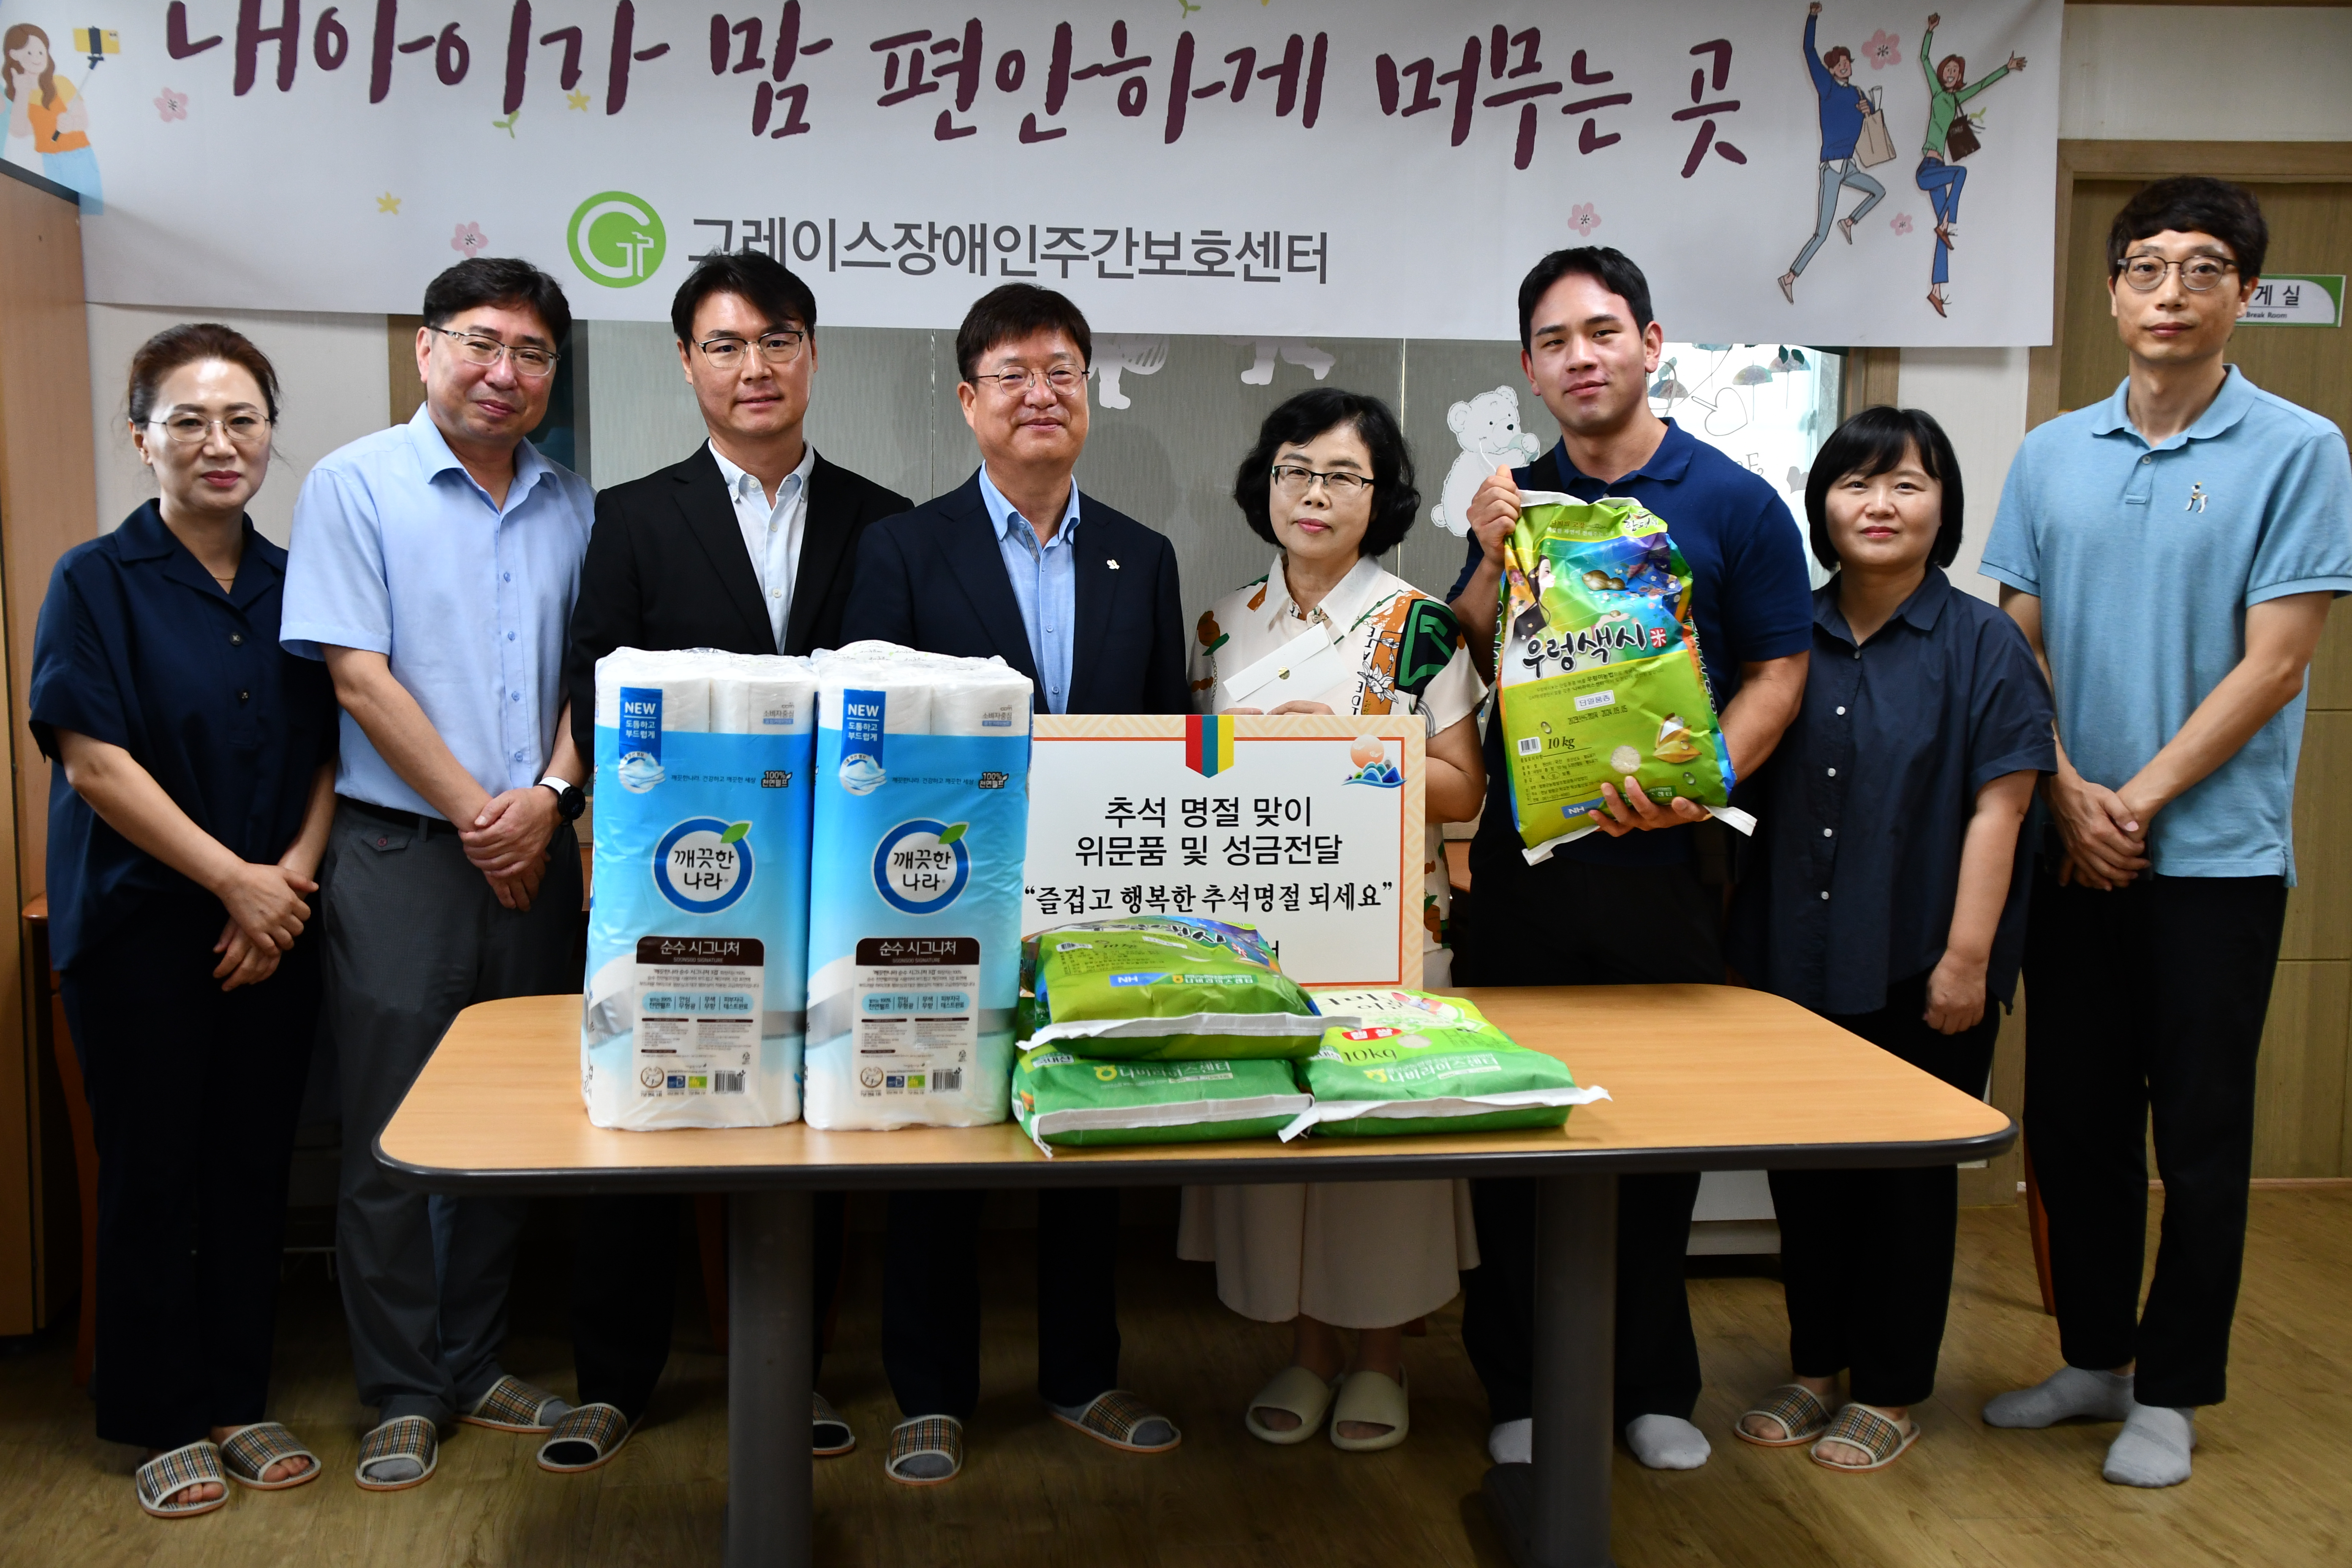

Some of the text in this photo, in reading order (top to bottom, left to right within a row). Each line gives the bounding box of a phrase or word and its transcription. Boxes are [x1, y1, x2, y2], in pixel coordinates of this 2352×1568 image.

[167, 0, 1748, 178] 내아이가 맘 편안하게 머무는 곳
[688, 216, 1328, 284] 그레이스장애인주간보호센터
[2254, 284, 2300, 306] 게실
[1522, 622, 1647, 680] 우렁색시
[625, 701, 656, 714] NEW
[1579, 694, 1611, 707] 단일품종
[848, 704, 879, 717] NEW
[625, 720, 656, 730] 도톰하고
[848, 722, 878, 732] 도톰하고
[625, 730, 656, 739] 부드럽게
[848, 732, 878, 742] 부드럽게
[1547, 736, 1576, 750] 10 kg
[765, 770, 787, 779] 100%
[983, 772, 1002, 781] 100%
[761, 779, 788, 787] 천연펄프
[979, 780, 1004, 789] 천연펄프
[1104, 796, 1312, 829] 추석 명절 맞이
[1568, 806, 1585, 815] NH
[1075, 834, 1343, 867] 위문품 및 성금전달
[674, 848, 735, 870] 깨끗한
[893, 849, 952, 871] 깨끗한
[683, 871, 723, 890] 나라
[903, 873, 941, 891] 나라
[1122, 885, 1197, 915] 행복한
[1201, 882, 1301, 913] 추석명절
[660, 941, 740, 957] 순수 시그니처
[879, 941, 957, 956] 순수 시그니처
[1118, 975, 1139, 984] NH
[1343, 1047, 1397, 1062] 10kg
